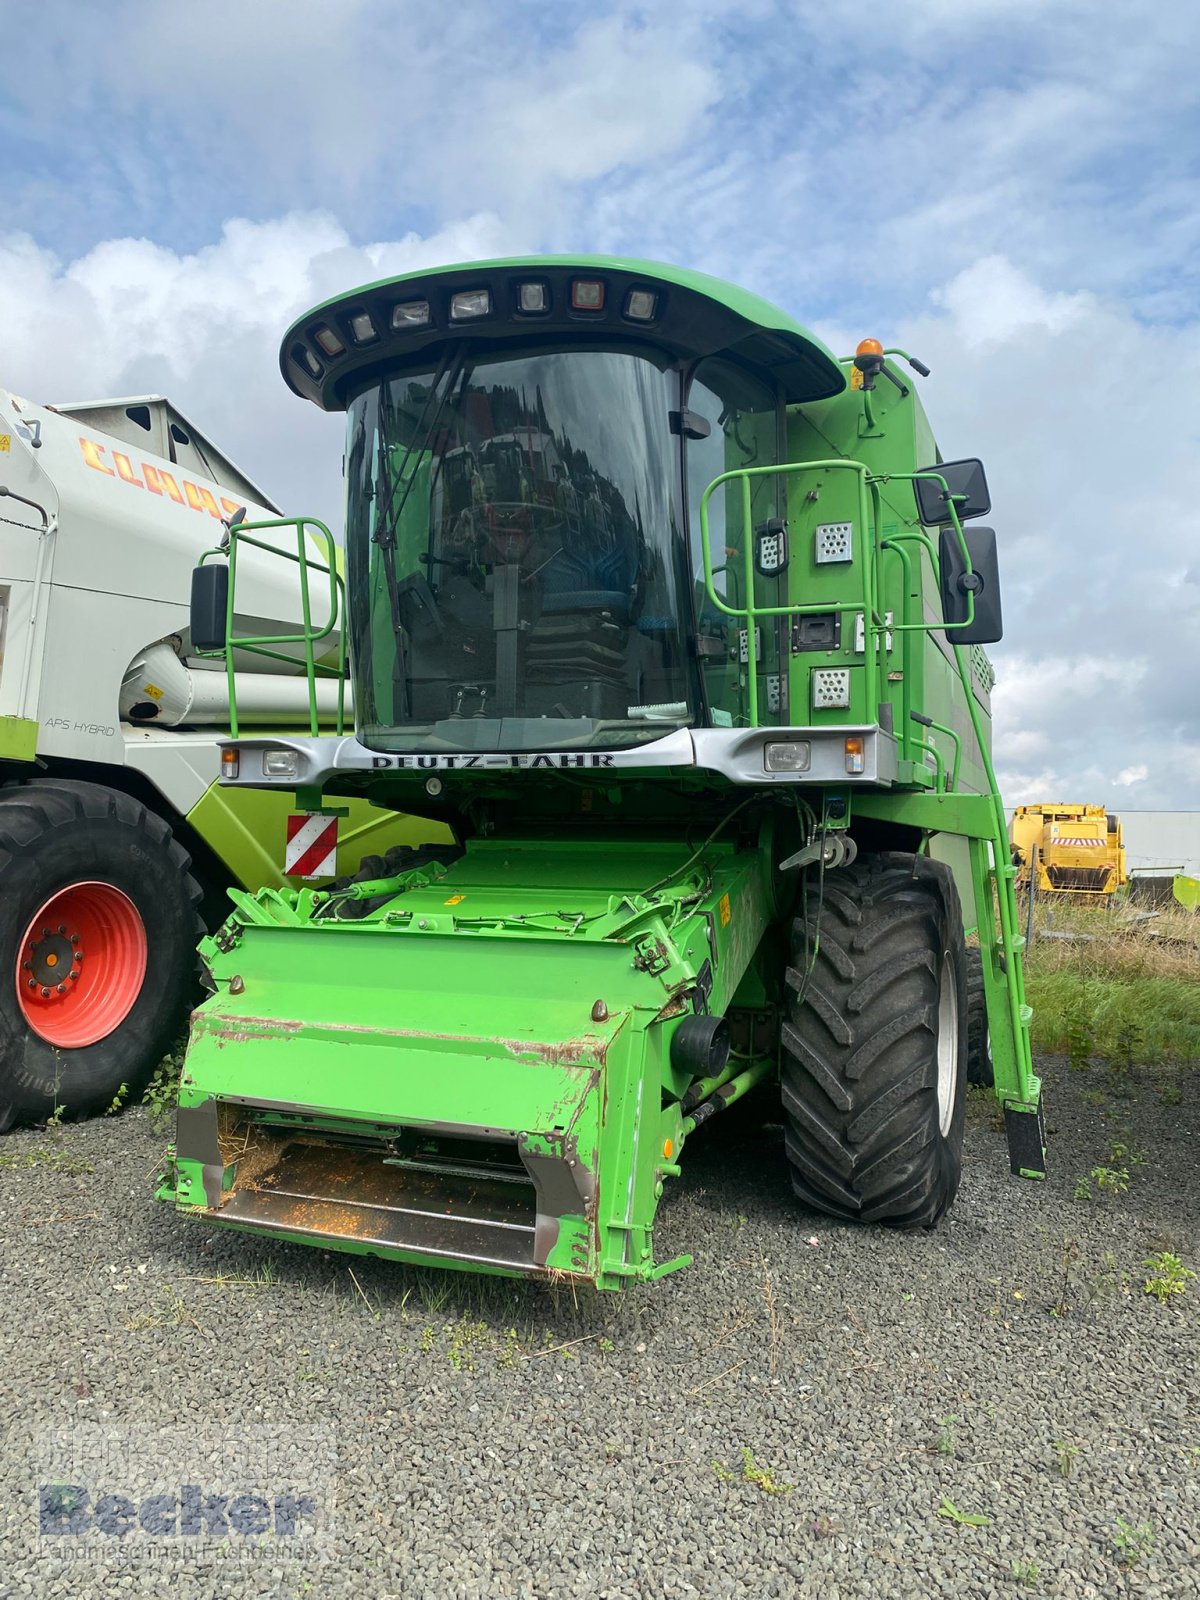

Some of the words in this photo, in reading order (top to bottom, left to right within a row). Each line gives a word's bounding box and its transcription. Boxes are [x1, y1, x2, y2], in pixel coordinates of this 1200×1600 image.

[46, 718, 70, 730] APS
[74, 722, 115, 736] HYBRID
[372, 754, 616, 768] DEUTZ-FAHR
